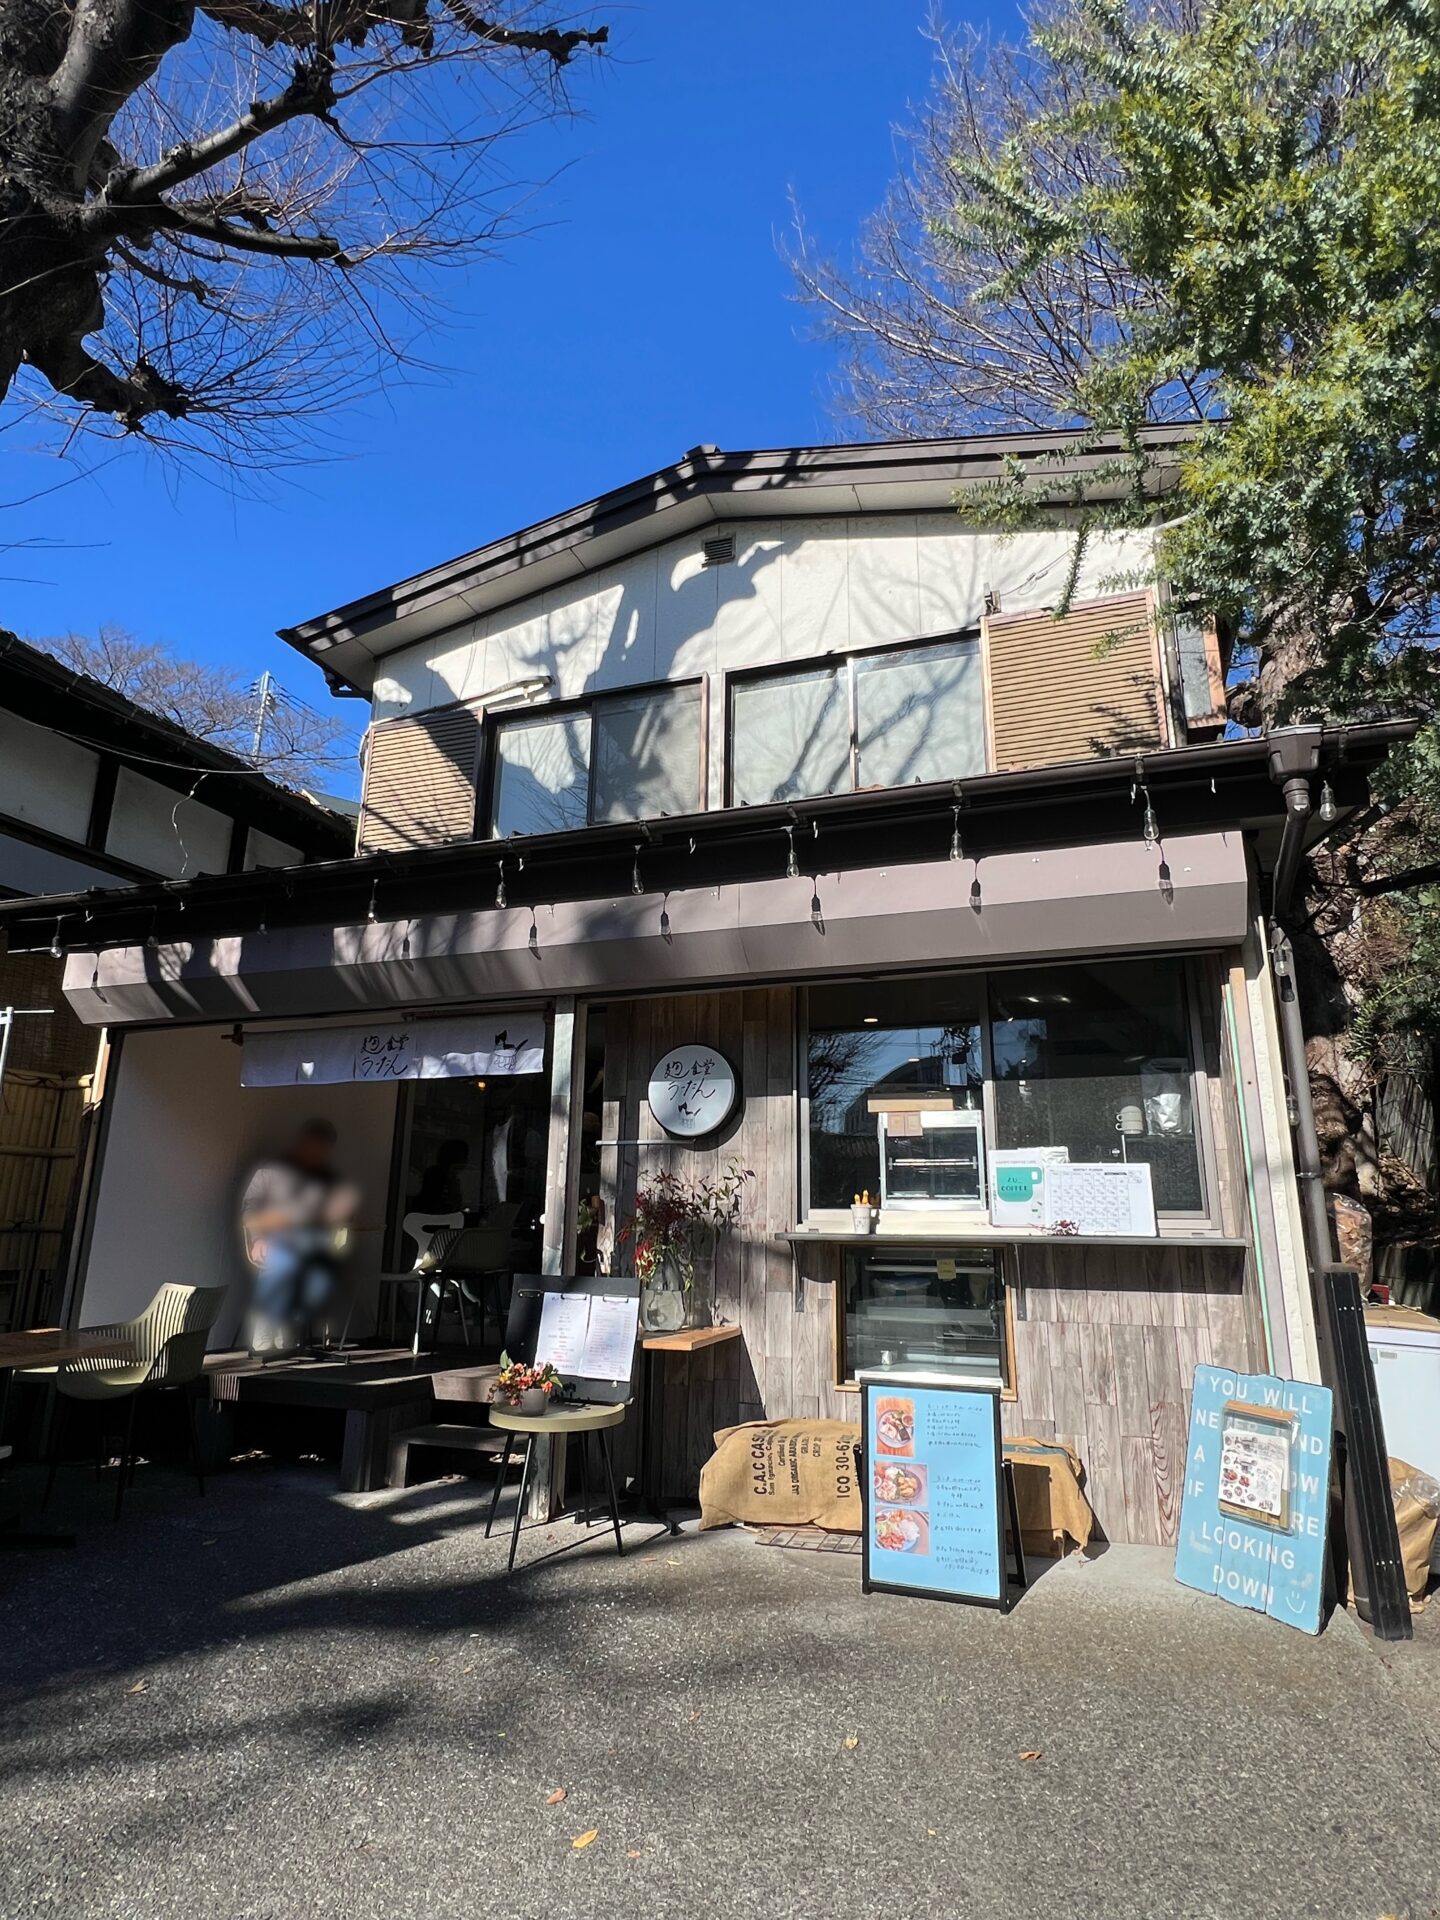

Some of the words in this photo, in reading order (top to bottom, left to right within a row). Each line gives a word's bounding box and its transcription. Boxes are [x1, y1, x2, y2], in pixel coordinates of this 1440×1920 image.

[1209, 1376, 1248, 1399] YOU
[1263, 1387, 1312, 1414] WILL
[1193, 1445, 1206, 1462] A
[836, 1475, 851, 1498] ICO
[1188, 1479, 1205, 1497] IF
[1201, 1521, 1295, 1569] LOOKING
[1212, 1564, 1274, 1605] DOWN
